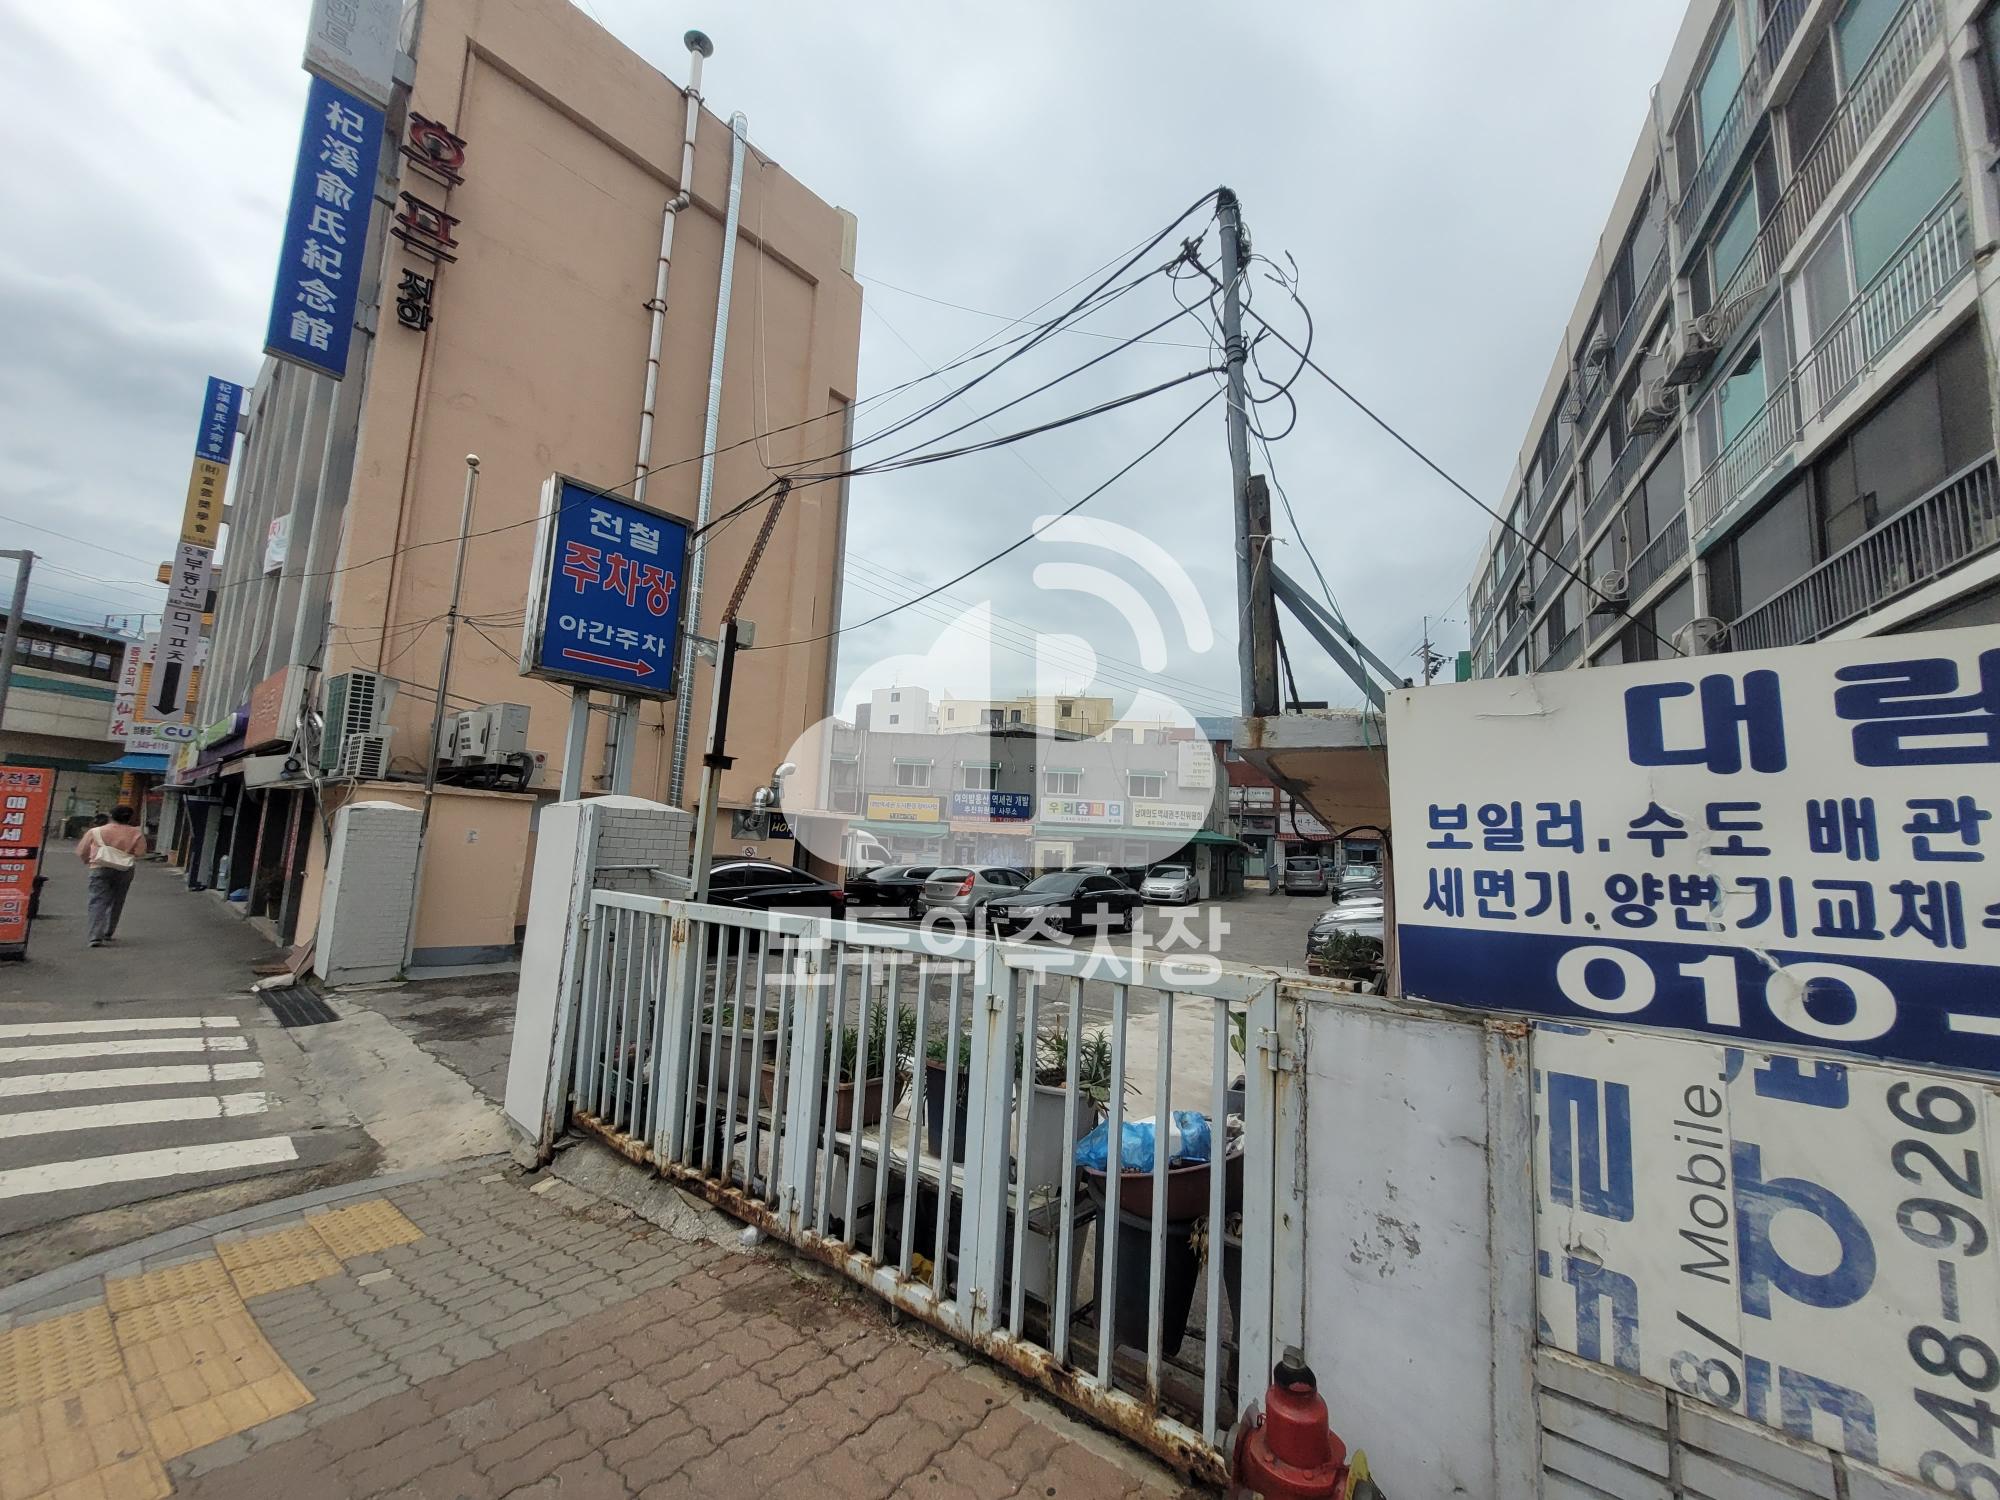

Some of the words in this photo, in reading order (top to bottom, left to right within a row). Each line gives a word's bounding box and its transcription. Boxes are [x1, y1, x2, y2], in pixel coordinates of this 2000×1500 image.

[589, 507, 660, 555] 전철
[179, 557, 203, 600] 부동산
[563, 541, 676, 616] 주차장
[559, 615, 666, 658] 야간주차
[164, 726, 193, 738] CU
[991, 794, 1013, 806] 역세권
[999, 807, 1018, 816] 사무소
[1049, 801, 1105, 816] 우리슈퍼
